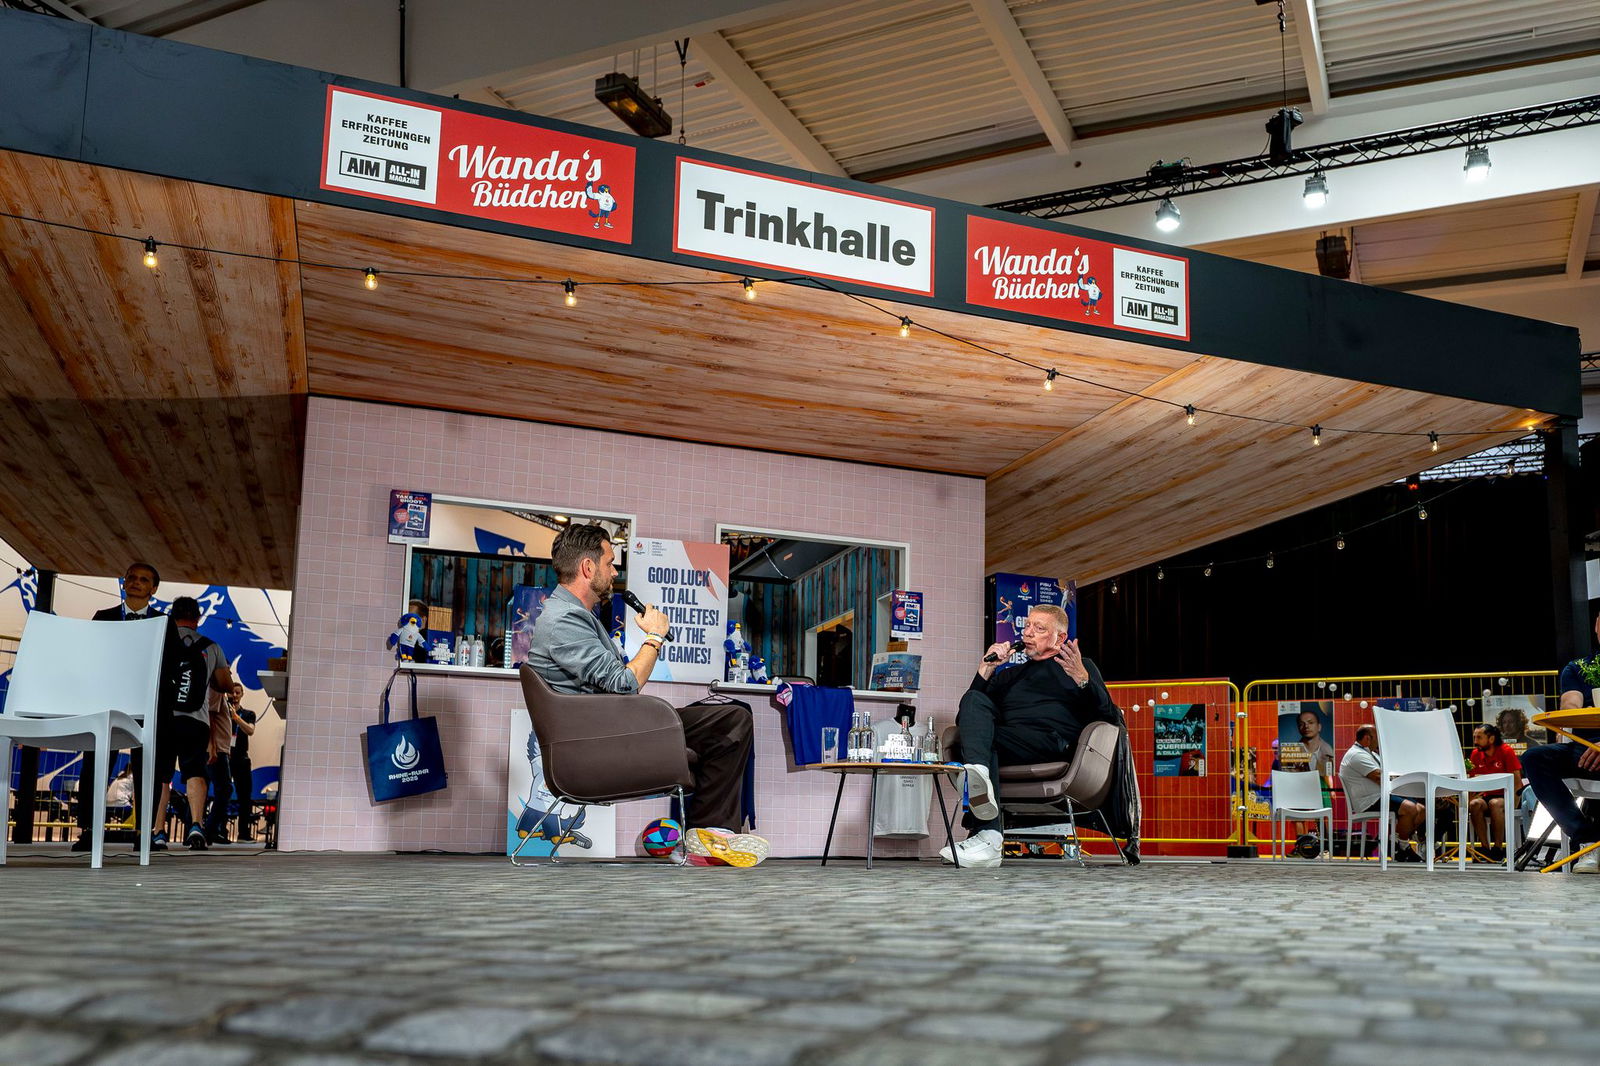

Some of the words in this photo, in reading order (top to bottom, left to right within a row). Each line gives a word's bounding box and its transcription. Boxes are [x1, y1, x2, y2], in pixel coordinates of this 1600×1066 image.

[367, 114, 408, 129] KAFFEE
[342, 120, 431, 144] ERFRISCHUNGEN
[362, 134, 408, 150] ZEITUNG
[347, 157, 380, 178] AIM
[390, 165, 420, 178] ALL-IN
[448, 144, 602, 182] Wanda's
[388, 174, 420, 186] MAGAZINE
[470, 180, 588, 210] Büdchen
[696, 188, 916, 266] Trinkhalle
[974, 245, 1090, 276] Wanda's
[1120, 271, 1180, 288] ERFRISCHUNGEN
[1136, 266, 1164, 276] KAFFEE
[992, 276, 1080, 300] Büdchen
[1135, 282, 1166, 294] ZEITUNG
[1126, 302, 1148, 317] AIM
[1154, 306, 1174, 316] ALL-IN
[648, 566, 678, 585] GOOD
[681, 568, 710, 587] LUCK
[661, 586, 675, 604] TO
[678, 588, 698, 606] ALL
[662, 606, 719, 626] ATHLETES!
[686, 627, 706, 644] THE
[668, 646, 712, 664] GAMES!
[177, 670, 192, 703] ITALIA
[388, 768, 429, 780] RHINE-RUHR
